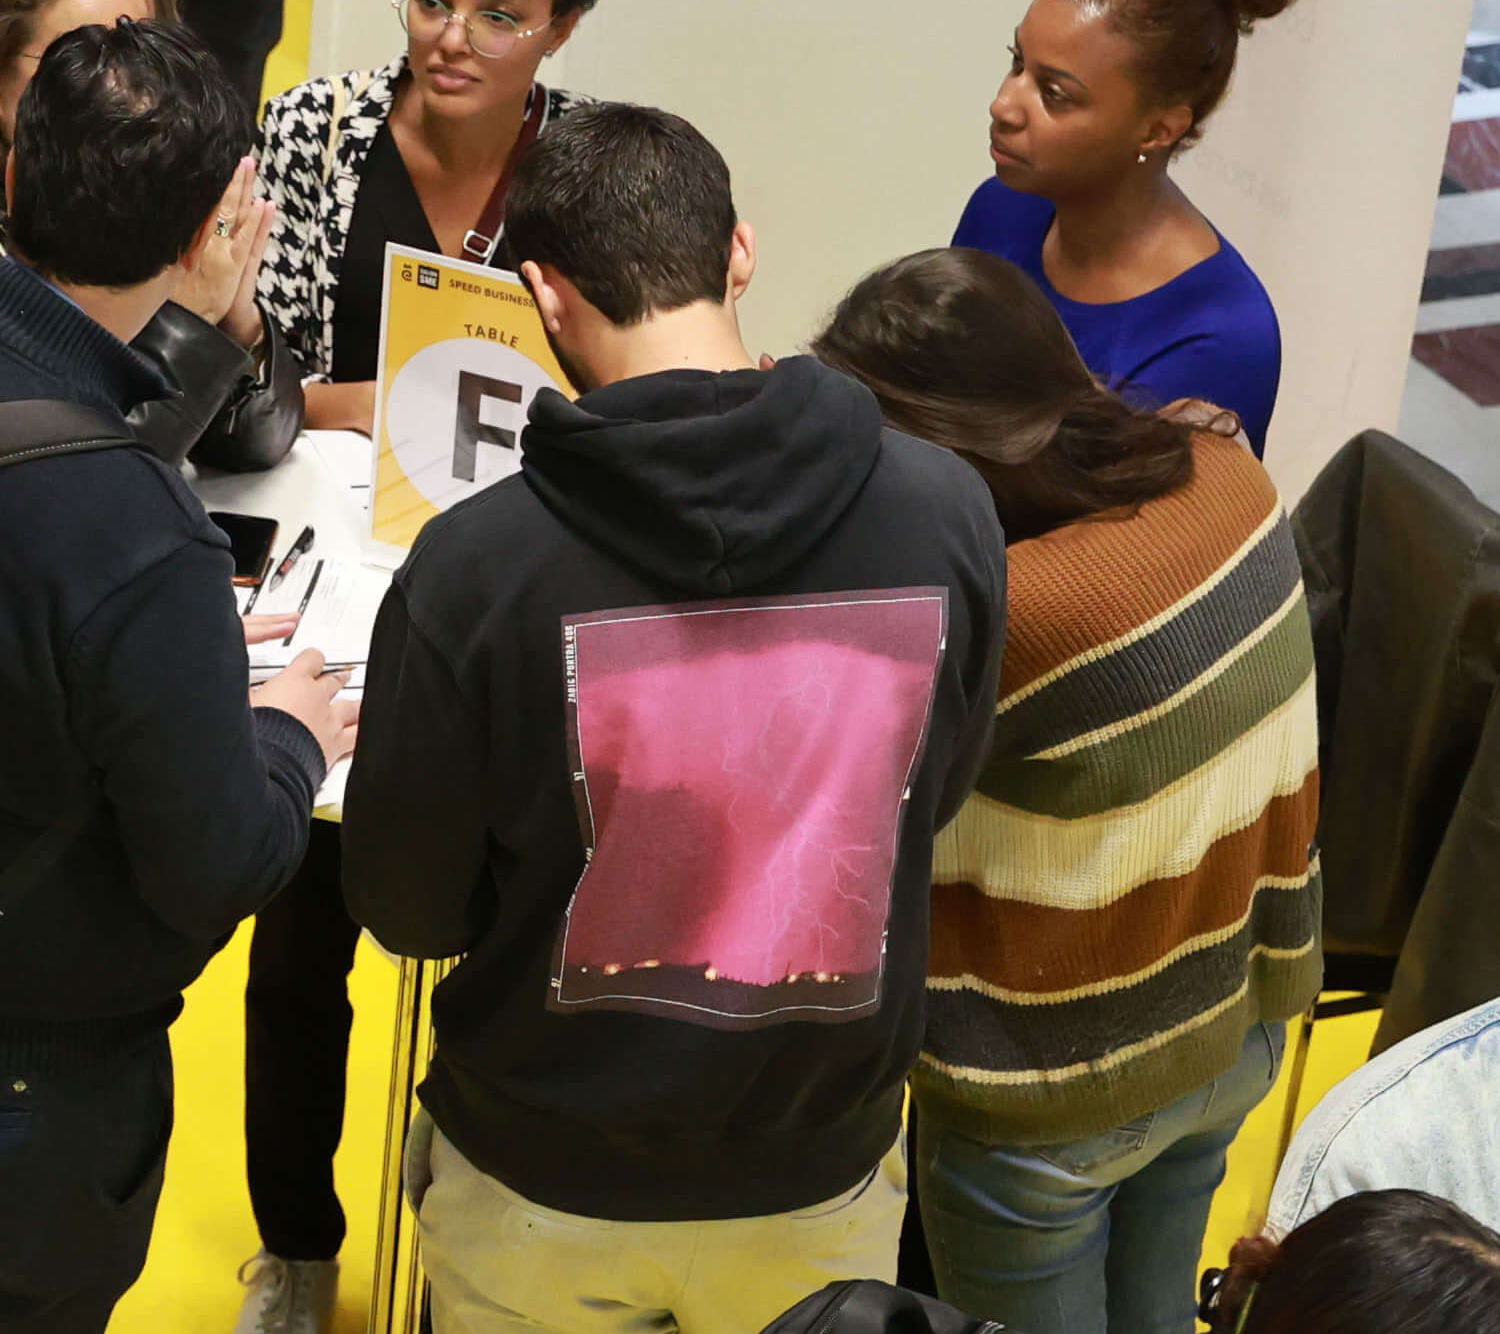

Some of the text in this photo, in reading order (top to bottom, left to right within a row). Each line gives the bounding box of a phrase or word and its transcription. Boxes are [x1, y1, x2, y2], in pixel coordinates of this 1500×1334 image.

[449, 278, 535, 308] SPEED BUSINESS
[464, 323, 519, 348] TABLE
[452, 370, 522, 483] F
[565, 643, 575, 676] PORTRA
